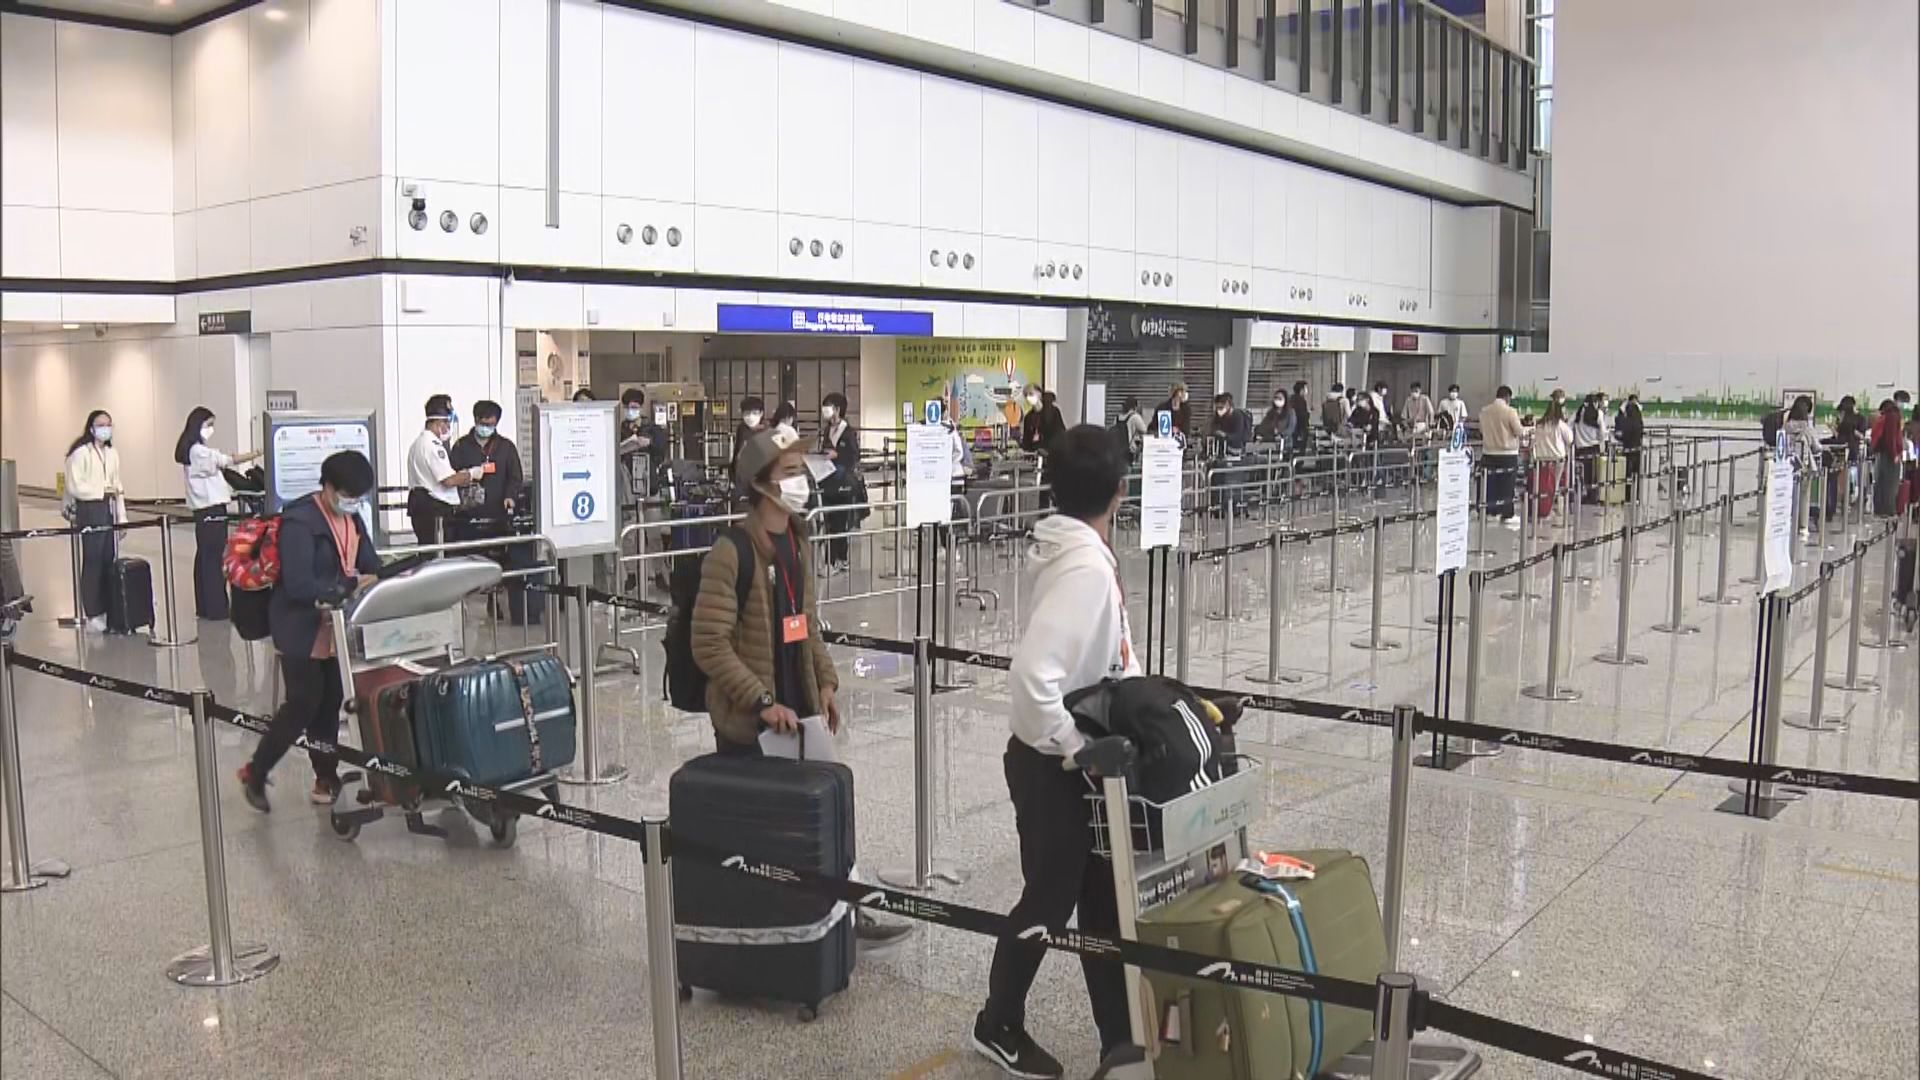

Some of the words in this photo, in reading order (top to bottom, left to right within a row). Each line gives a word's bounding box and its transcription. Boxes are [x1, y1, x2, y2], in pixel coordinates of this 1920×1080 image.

[902, 343, 928, 352] Leave
[931, 344, 951, 354] your
[979, 342, 1002, 352] with
[1005, 343, 1016, 352] us
[902, 355, 918, 364] and
[921, 355, 956, 366] explore
[959, 355, 974, 364] the
[576, 494, 590, 518] 8
